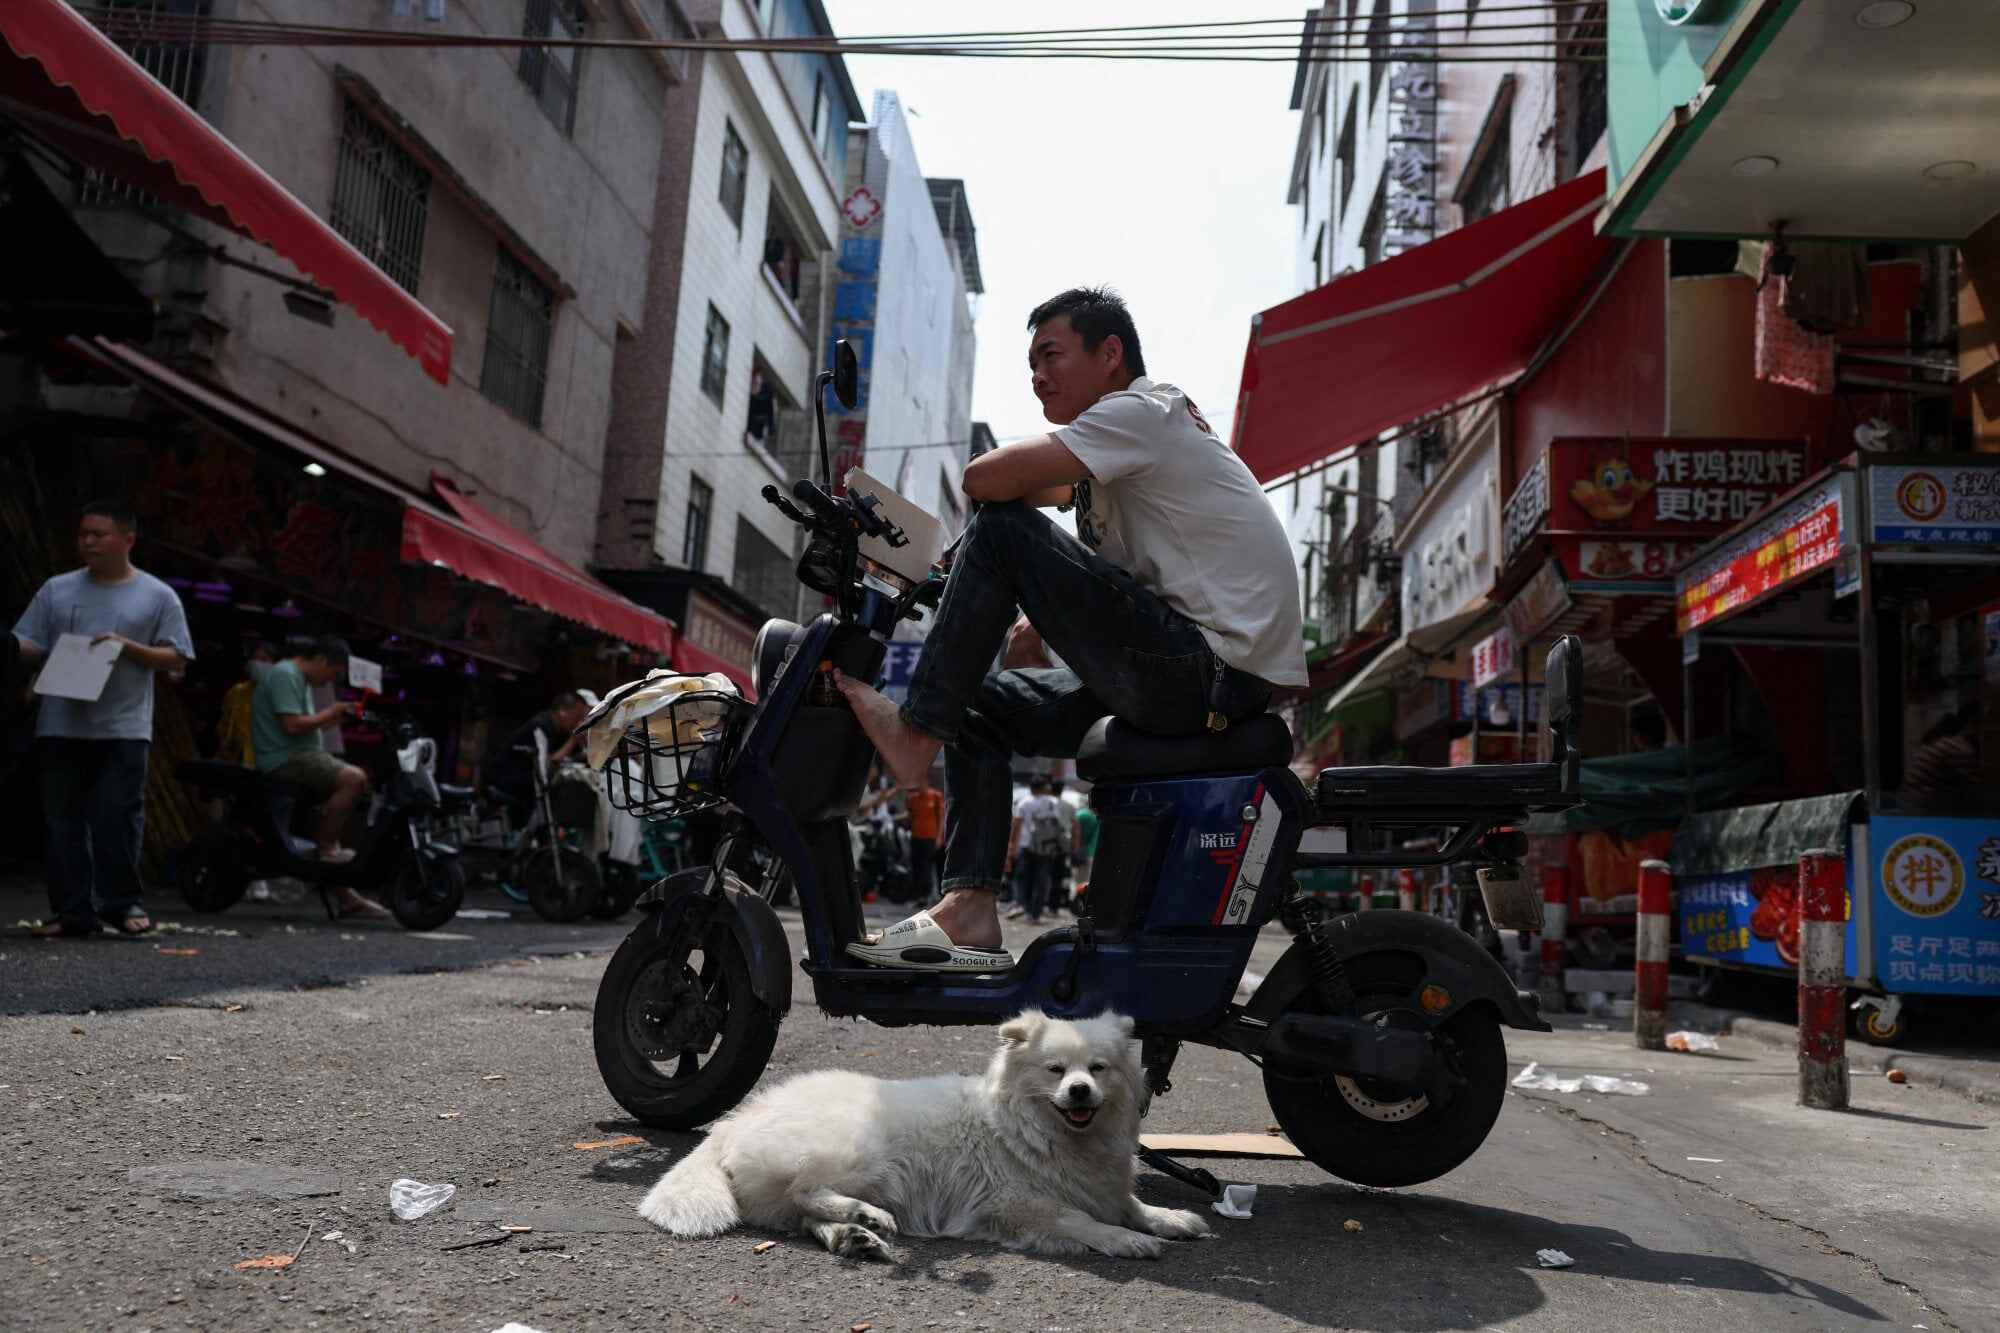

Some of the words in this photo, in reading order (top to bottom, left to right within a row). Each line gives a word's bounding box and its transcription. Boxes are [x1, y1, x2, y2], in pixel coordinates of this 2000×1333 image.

[1653, 449, 1803, 484] 炸鸡现炸
[1655, 487, 1778, 522] 更好吃
[1902, 853, 1948, 897] 拌
